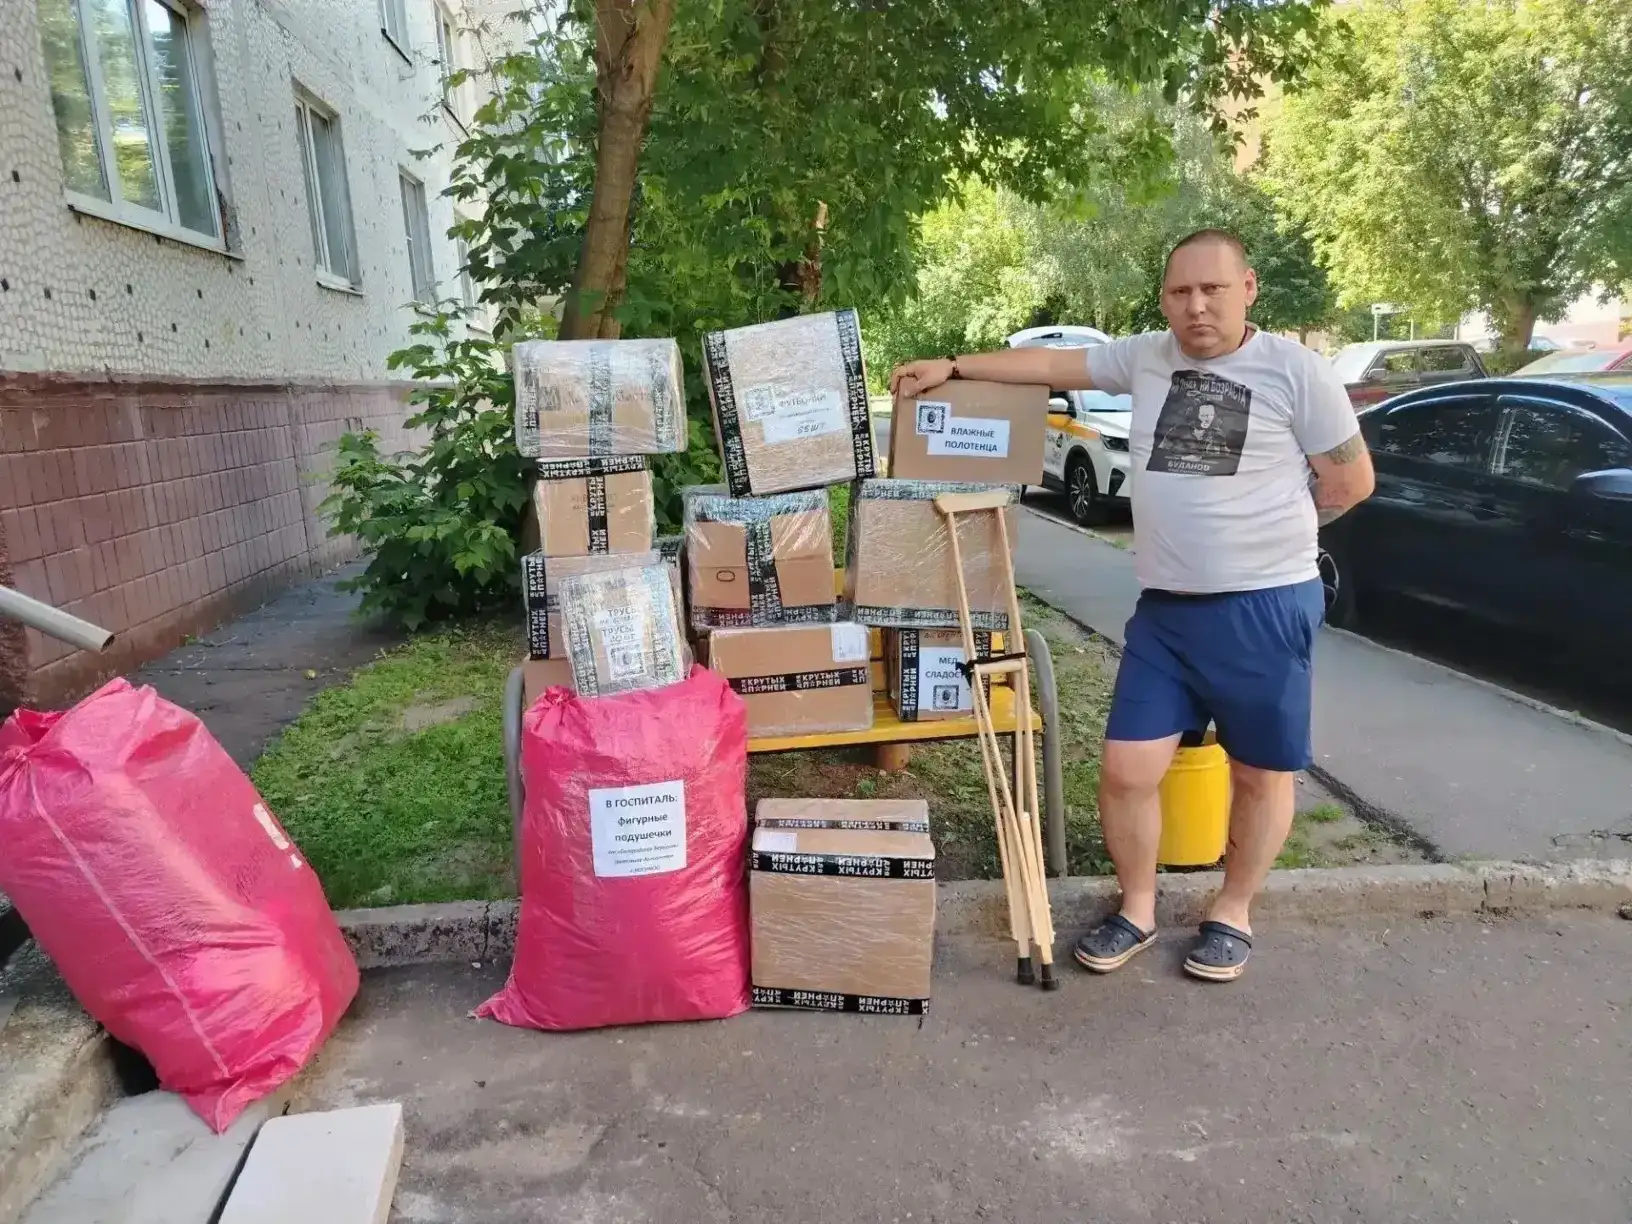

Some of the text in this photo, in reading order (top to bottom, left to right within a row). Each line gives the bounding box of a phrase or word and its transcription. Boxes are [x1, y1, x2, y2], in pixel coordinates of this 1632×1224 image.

[950, 427, 995, 438] ВЛАЖНЫЕ
[944, 440, 997, 452] ПОЛОТЕНЦА
[531, 611, 539, 648] КРУТЫХ
[939, 657, 958, 665] МЕД
[748, 676, 786, 686] КРУТЫХ
[803, 671, 840, 681] КРУТЫХ
[902, 668, 910, 704] КРУТЫХ
[606, 794, 678, 808] В ГОСПИТАЛЬ:
[617, 813, 668, 827] фигурные
[615, 830, 672, 843] подушечки
[771, 863, 816, 873] КРУТЫХ
[838, 867, 882, 876] КРУТЫХ
[794, 1000, 836, 1009] КРУТЫХ
[858, 1005, 901, 1014] КРУТЫХ
